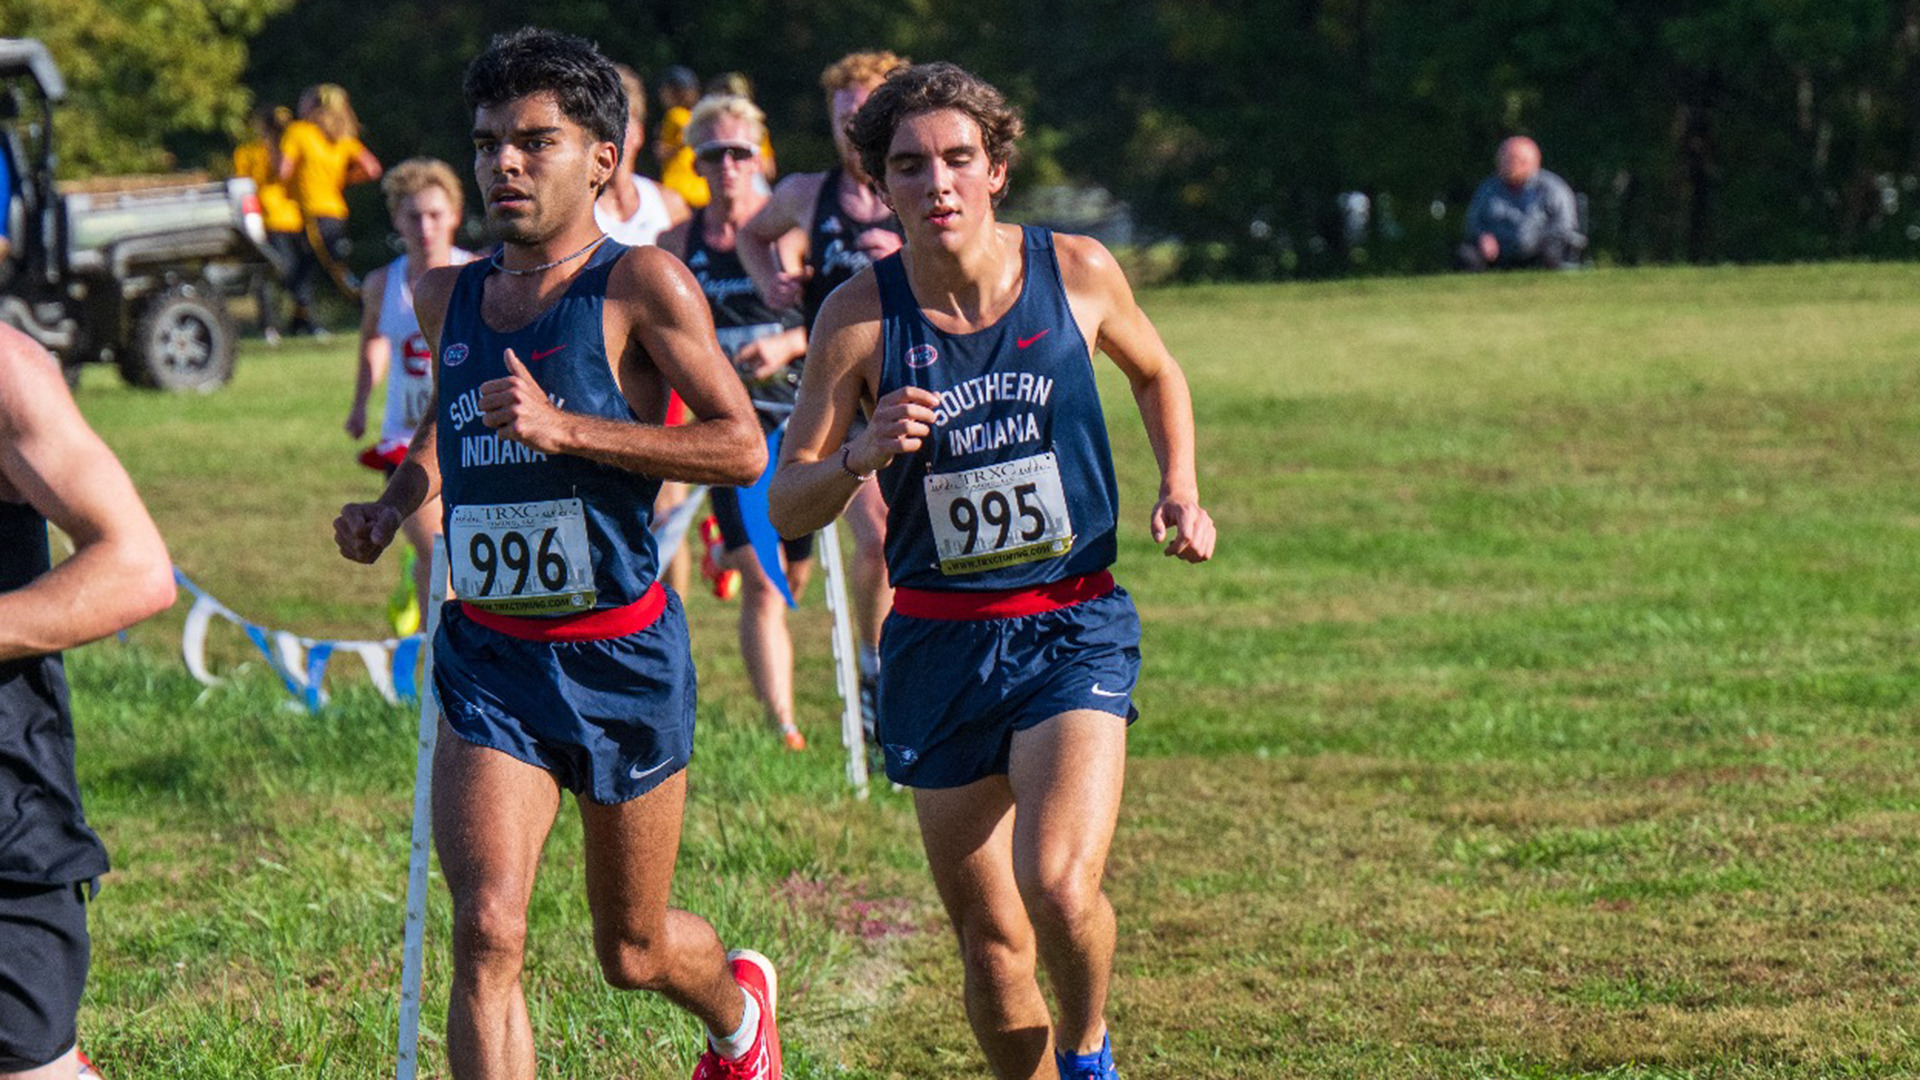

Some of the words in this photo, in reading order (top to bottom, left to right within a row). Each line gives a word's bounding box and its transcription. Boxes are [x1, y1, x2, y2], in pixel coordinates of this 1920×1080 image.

[935, 373, 1053, 426] SOUTHERN
[949, 412, 1041, 456] INDIANA
[958, 463, 1016, 485] TRXC
[481, 505, 537, 520] TRXC
[949, 482, 1045, 555] 995
[470, 526, 567, 596] 996
